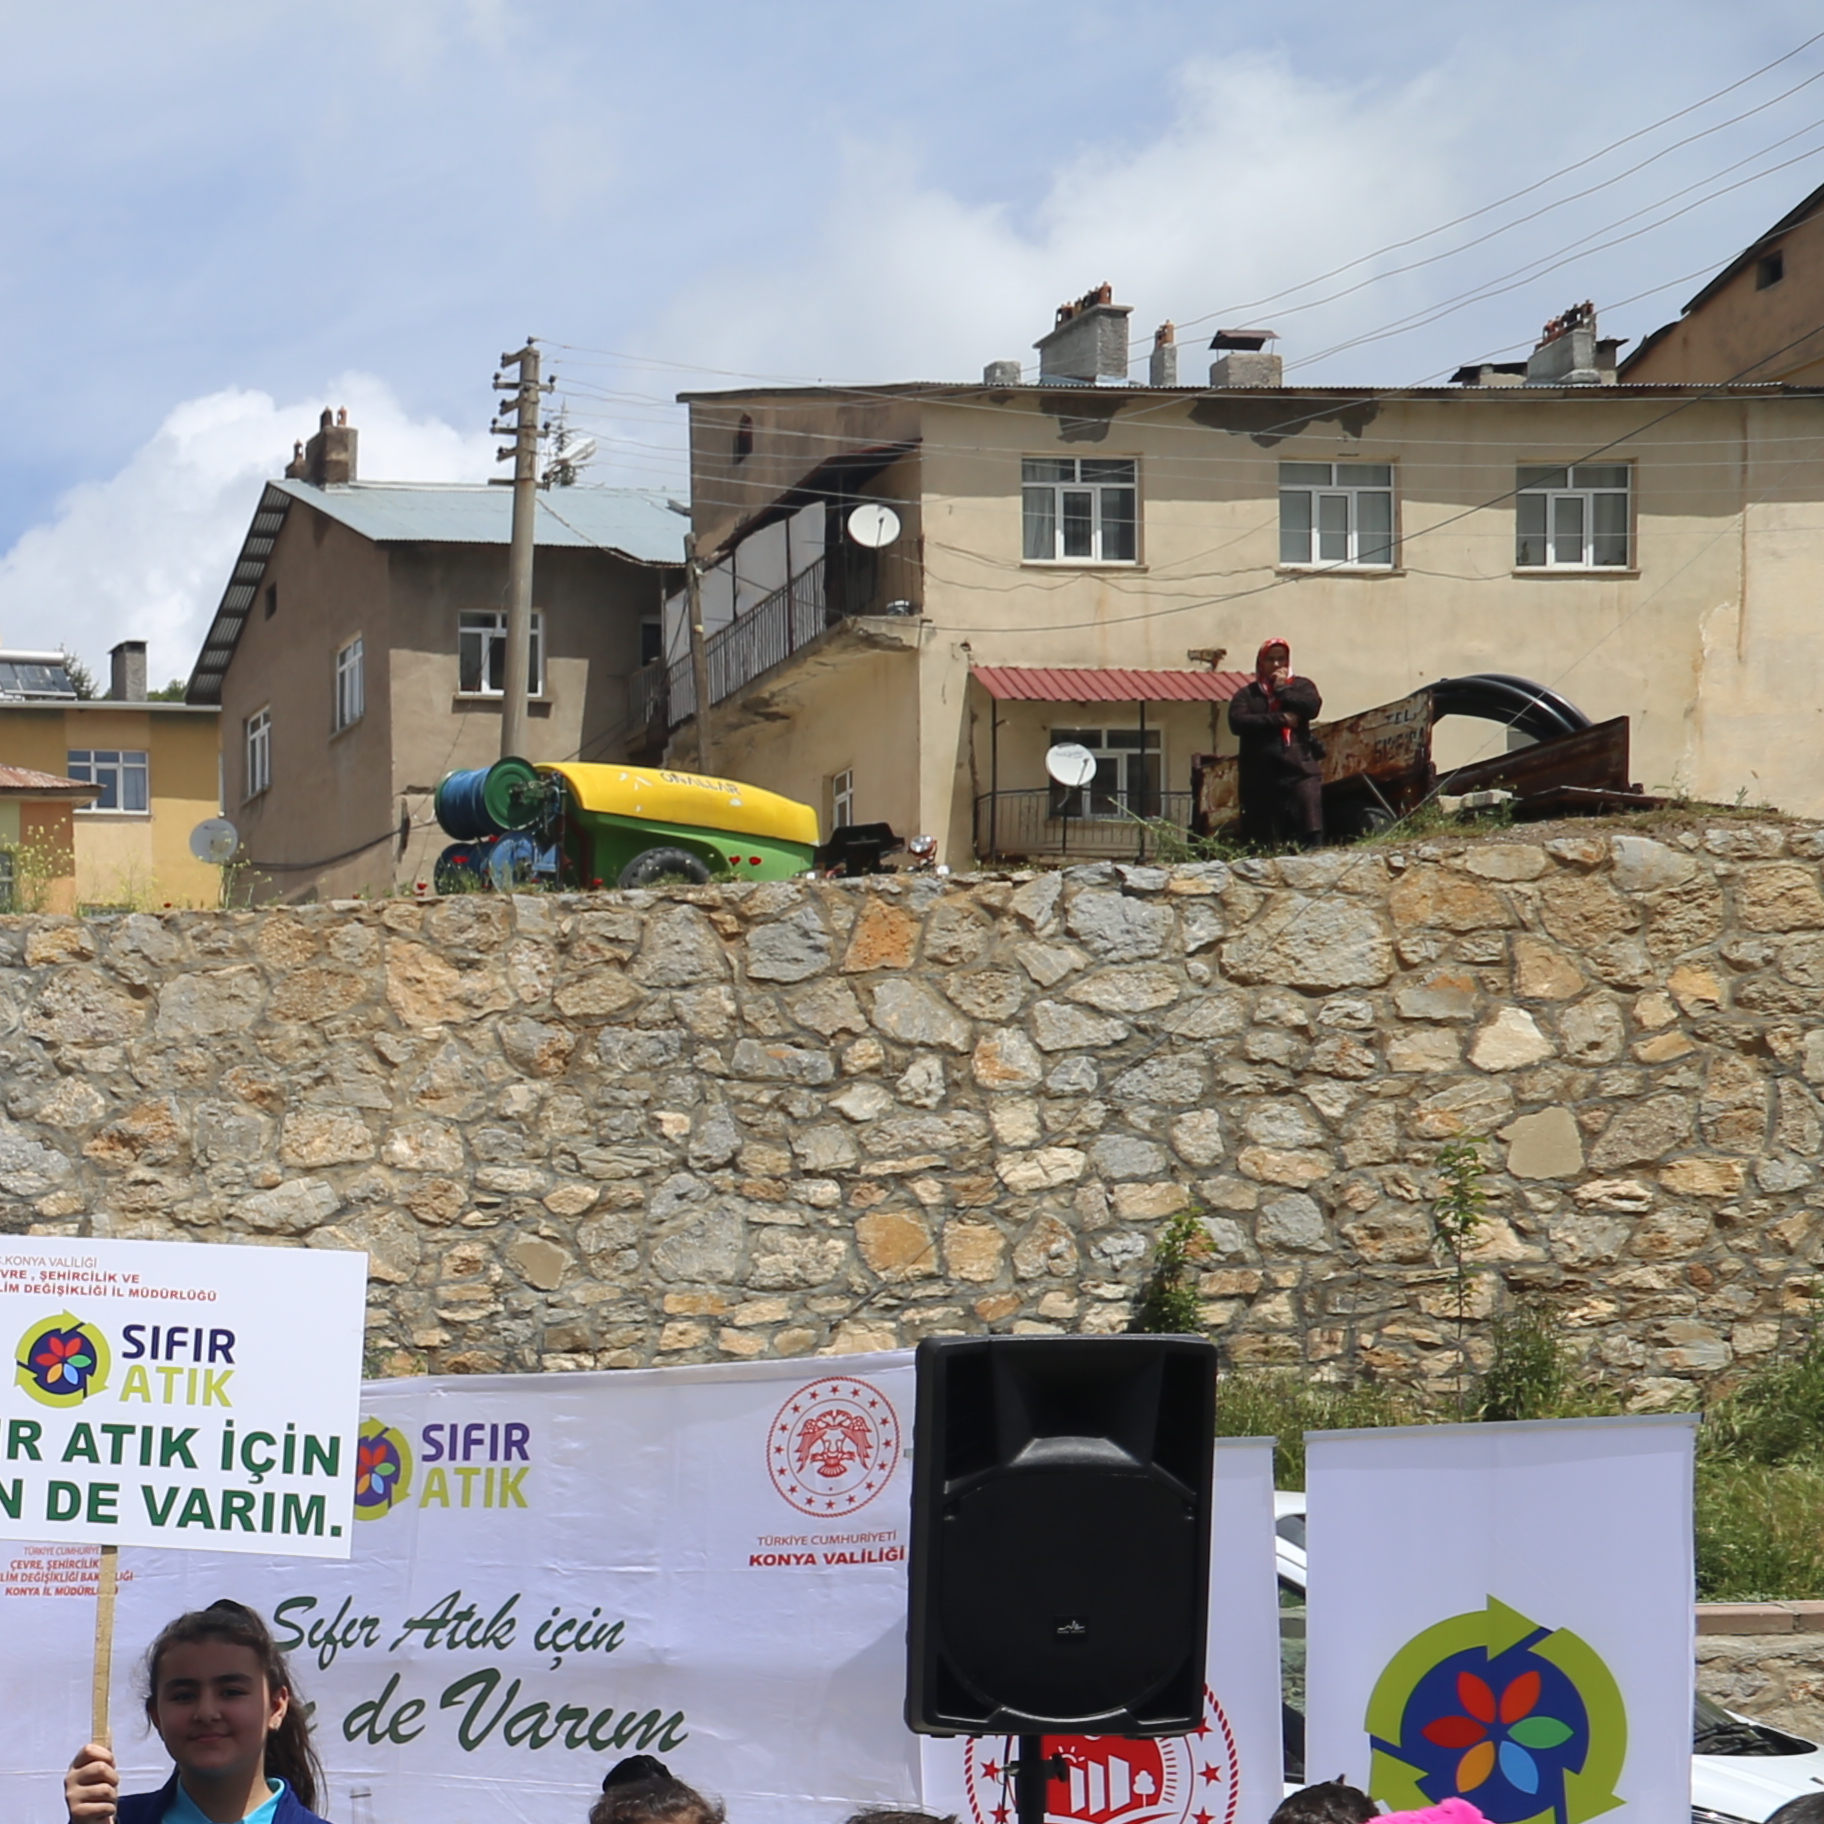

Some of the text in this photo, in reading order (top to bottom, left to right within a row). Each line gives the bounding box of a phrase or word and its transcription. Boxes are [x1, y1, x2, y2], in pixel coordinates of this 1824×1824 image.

[39, 1270, 118, 1284] ŞEHİRCİLİK
[121, 1273, 140, 1284] VE
[48, 1256, 98, 1269] VALİLİĞİ
[24, 1283, 108, 1297] DEĞİŞİKLİĞİ
[111, 1285, 125, 1297] İL
[129, 1286, 217, 1301] MÜDÜRLÜĞÜ
[121, 1323, 236, 1365] SIFIR
[118, 1363, 236, 1408] ATIK
[60, 1421, 200, 1469] ATIK
[219, 1418, 342, 1484] İÇİN
[420, 1421, 531, 1463] SIFIR
[419, 1466, 531, 1510] ATIK
[45, 1480, 121, 1525] DE
[140, 1483, 344, 1538] VARIM.
[55, 1546, 100, 1556] CUMHURİYE
[757, 1529, 897, 1547] TÜRKİYE CUMHURİYETİ
[749, 1545, 905, 1567] KONYA VALİLİĞİ
[5, 1586, 40, 1596] KONYA
[342, 1672, 427, 1745] de
